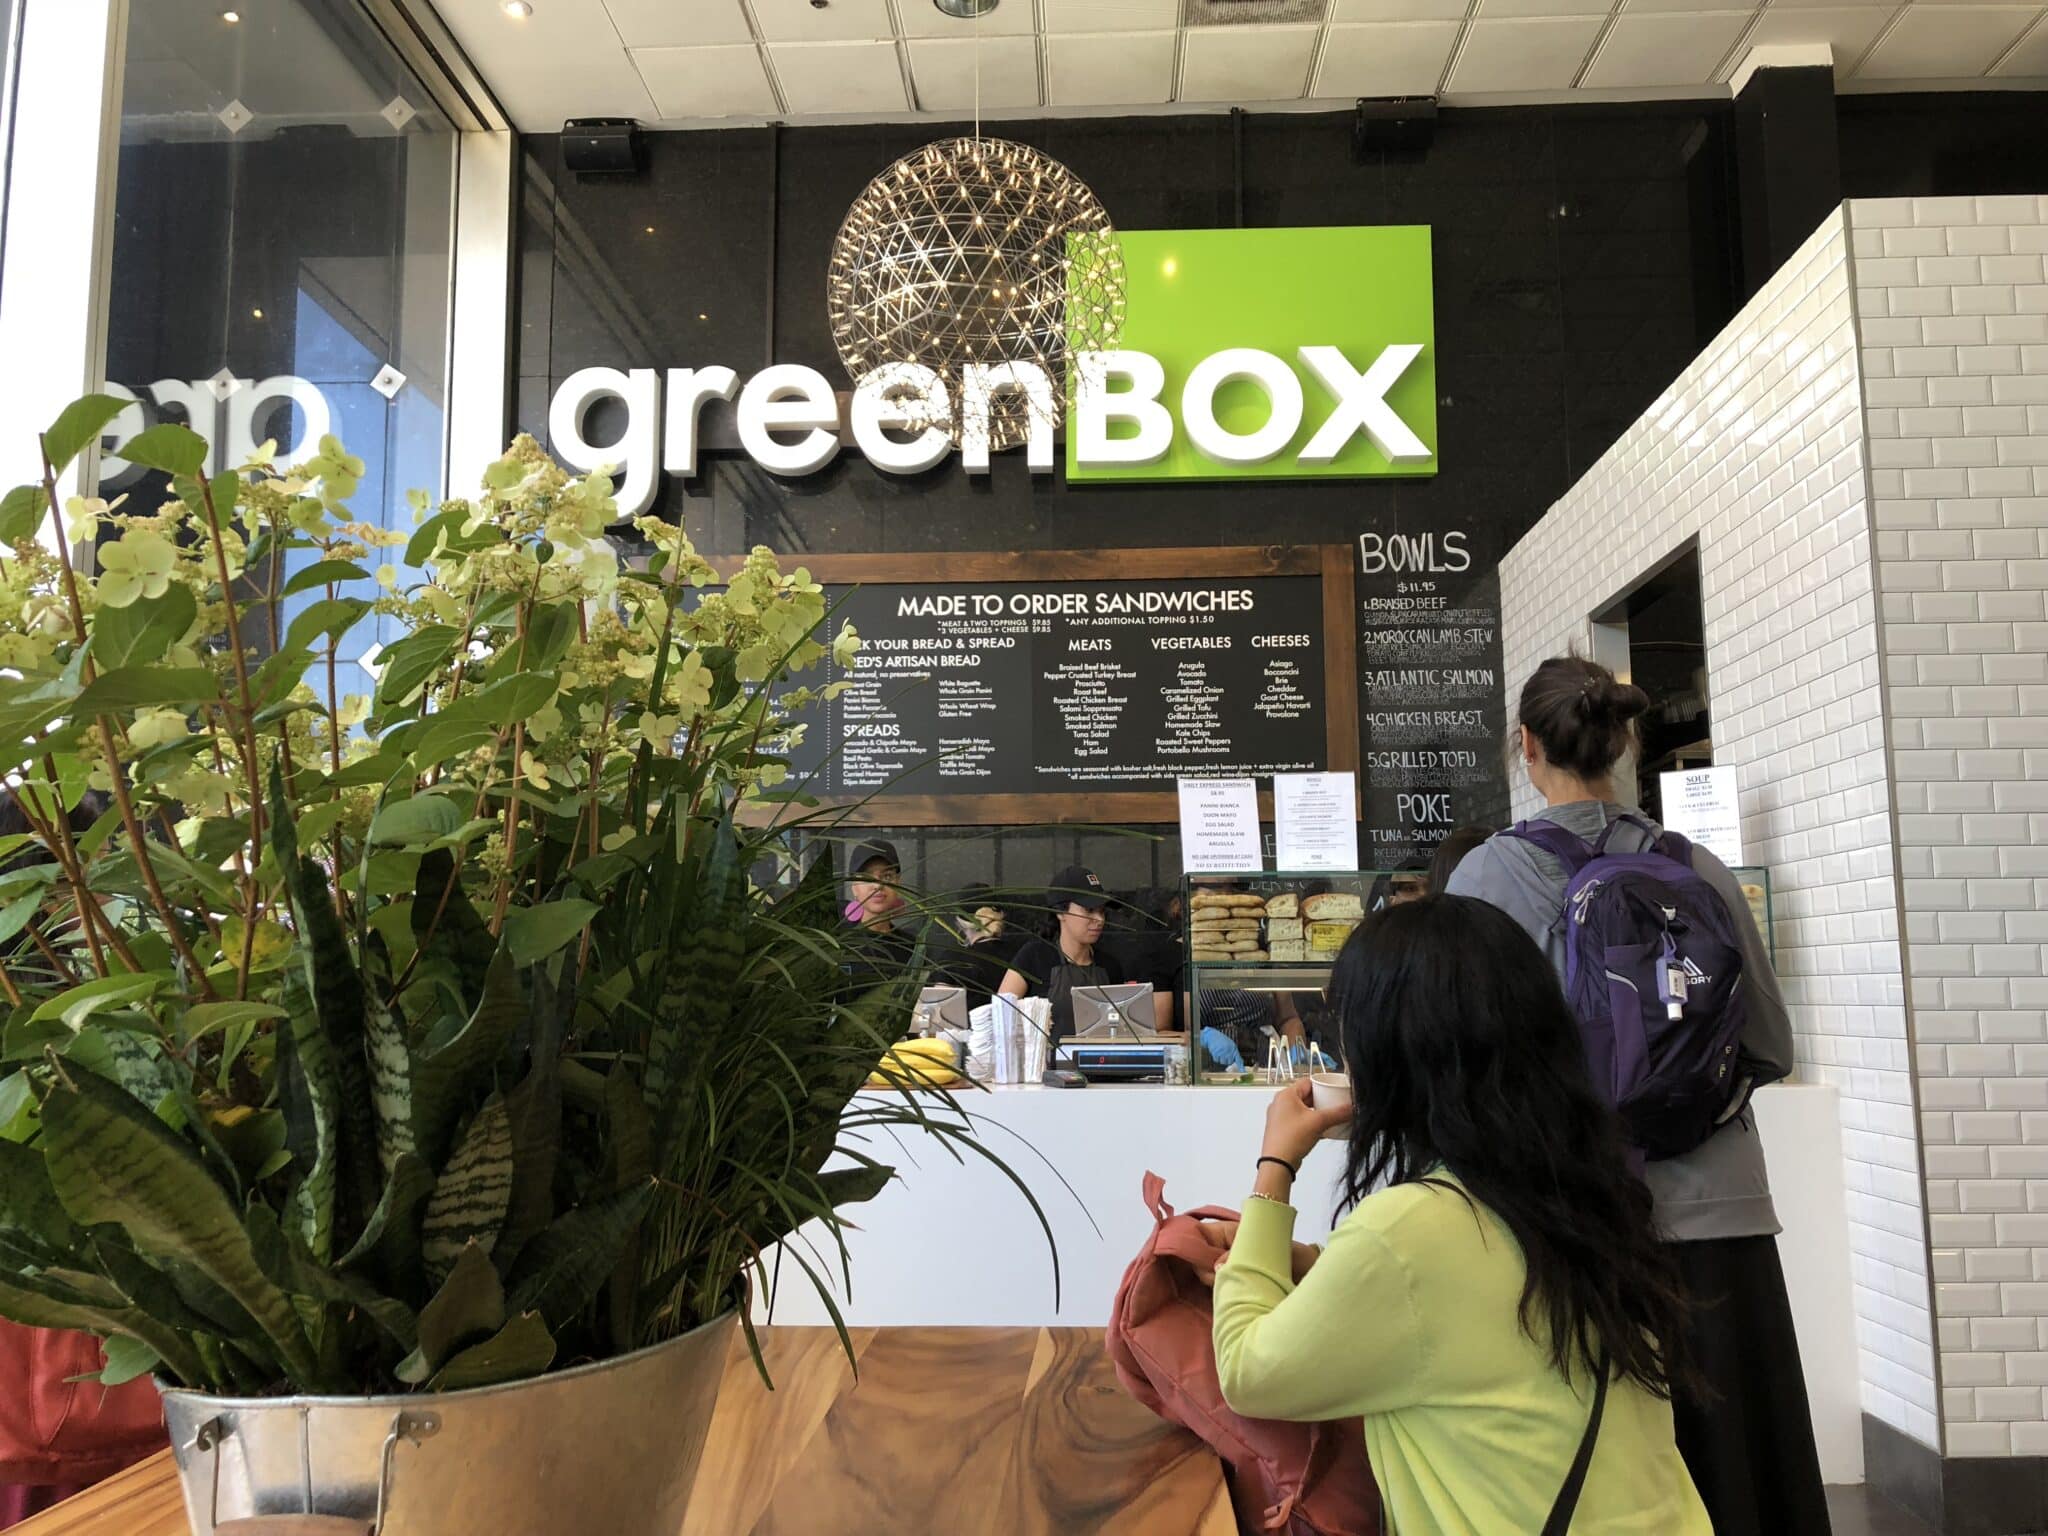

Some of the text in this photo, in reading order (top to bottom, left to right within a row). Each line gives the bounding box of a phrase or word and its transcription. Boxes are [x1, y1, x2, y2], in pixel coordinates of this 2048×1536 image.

[1360, 531, 1470, 573] BOWLS
[1398, 582, 1436, 593] $11.95
[898, 590, 1254, 616] MADE TO ORDER SANDWICHES
[1417, 597, 1448, 609] BEEF
[1190, 615, 1214, 624] $1.50
[1251, 635, 1310, 647] CHEESES
[1432, 629, 1461, 644] LAMB
[1464, 628, 1492, 643] STEW
[874, 639, 909, 650] YOUR
[913, 638, 952, 649] BREAD
[956, 638, 964, 649] &
[969, 637, 1015, 648] SPREAD
[1068, 639, 1112, 650] MEATS
[1151, 637, 1232, 650] VEGETABLES
[885, 656, 938, 668] ARTISAN
[941, 655, 980, 666] BREAD
[1443, 670, 1494, 685] SALMON
[1434, 710, 1483, 725] BREAST
[843, 724, 900, 737] SPREADS
[1439, 751, 1476, 767] TOFU
[1686, 774, 1710, 784] SOUP
[1397, 794, 1454, 822] POKE
[1370, 830, 1402, 842] TUNA
